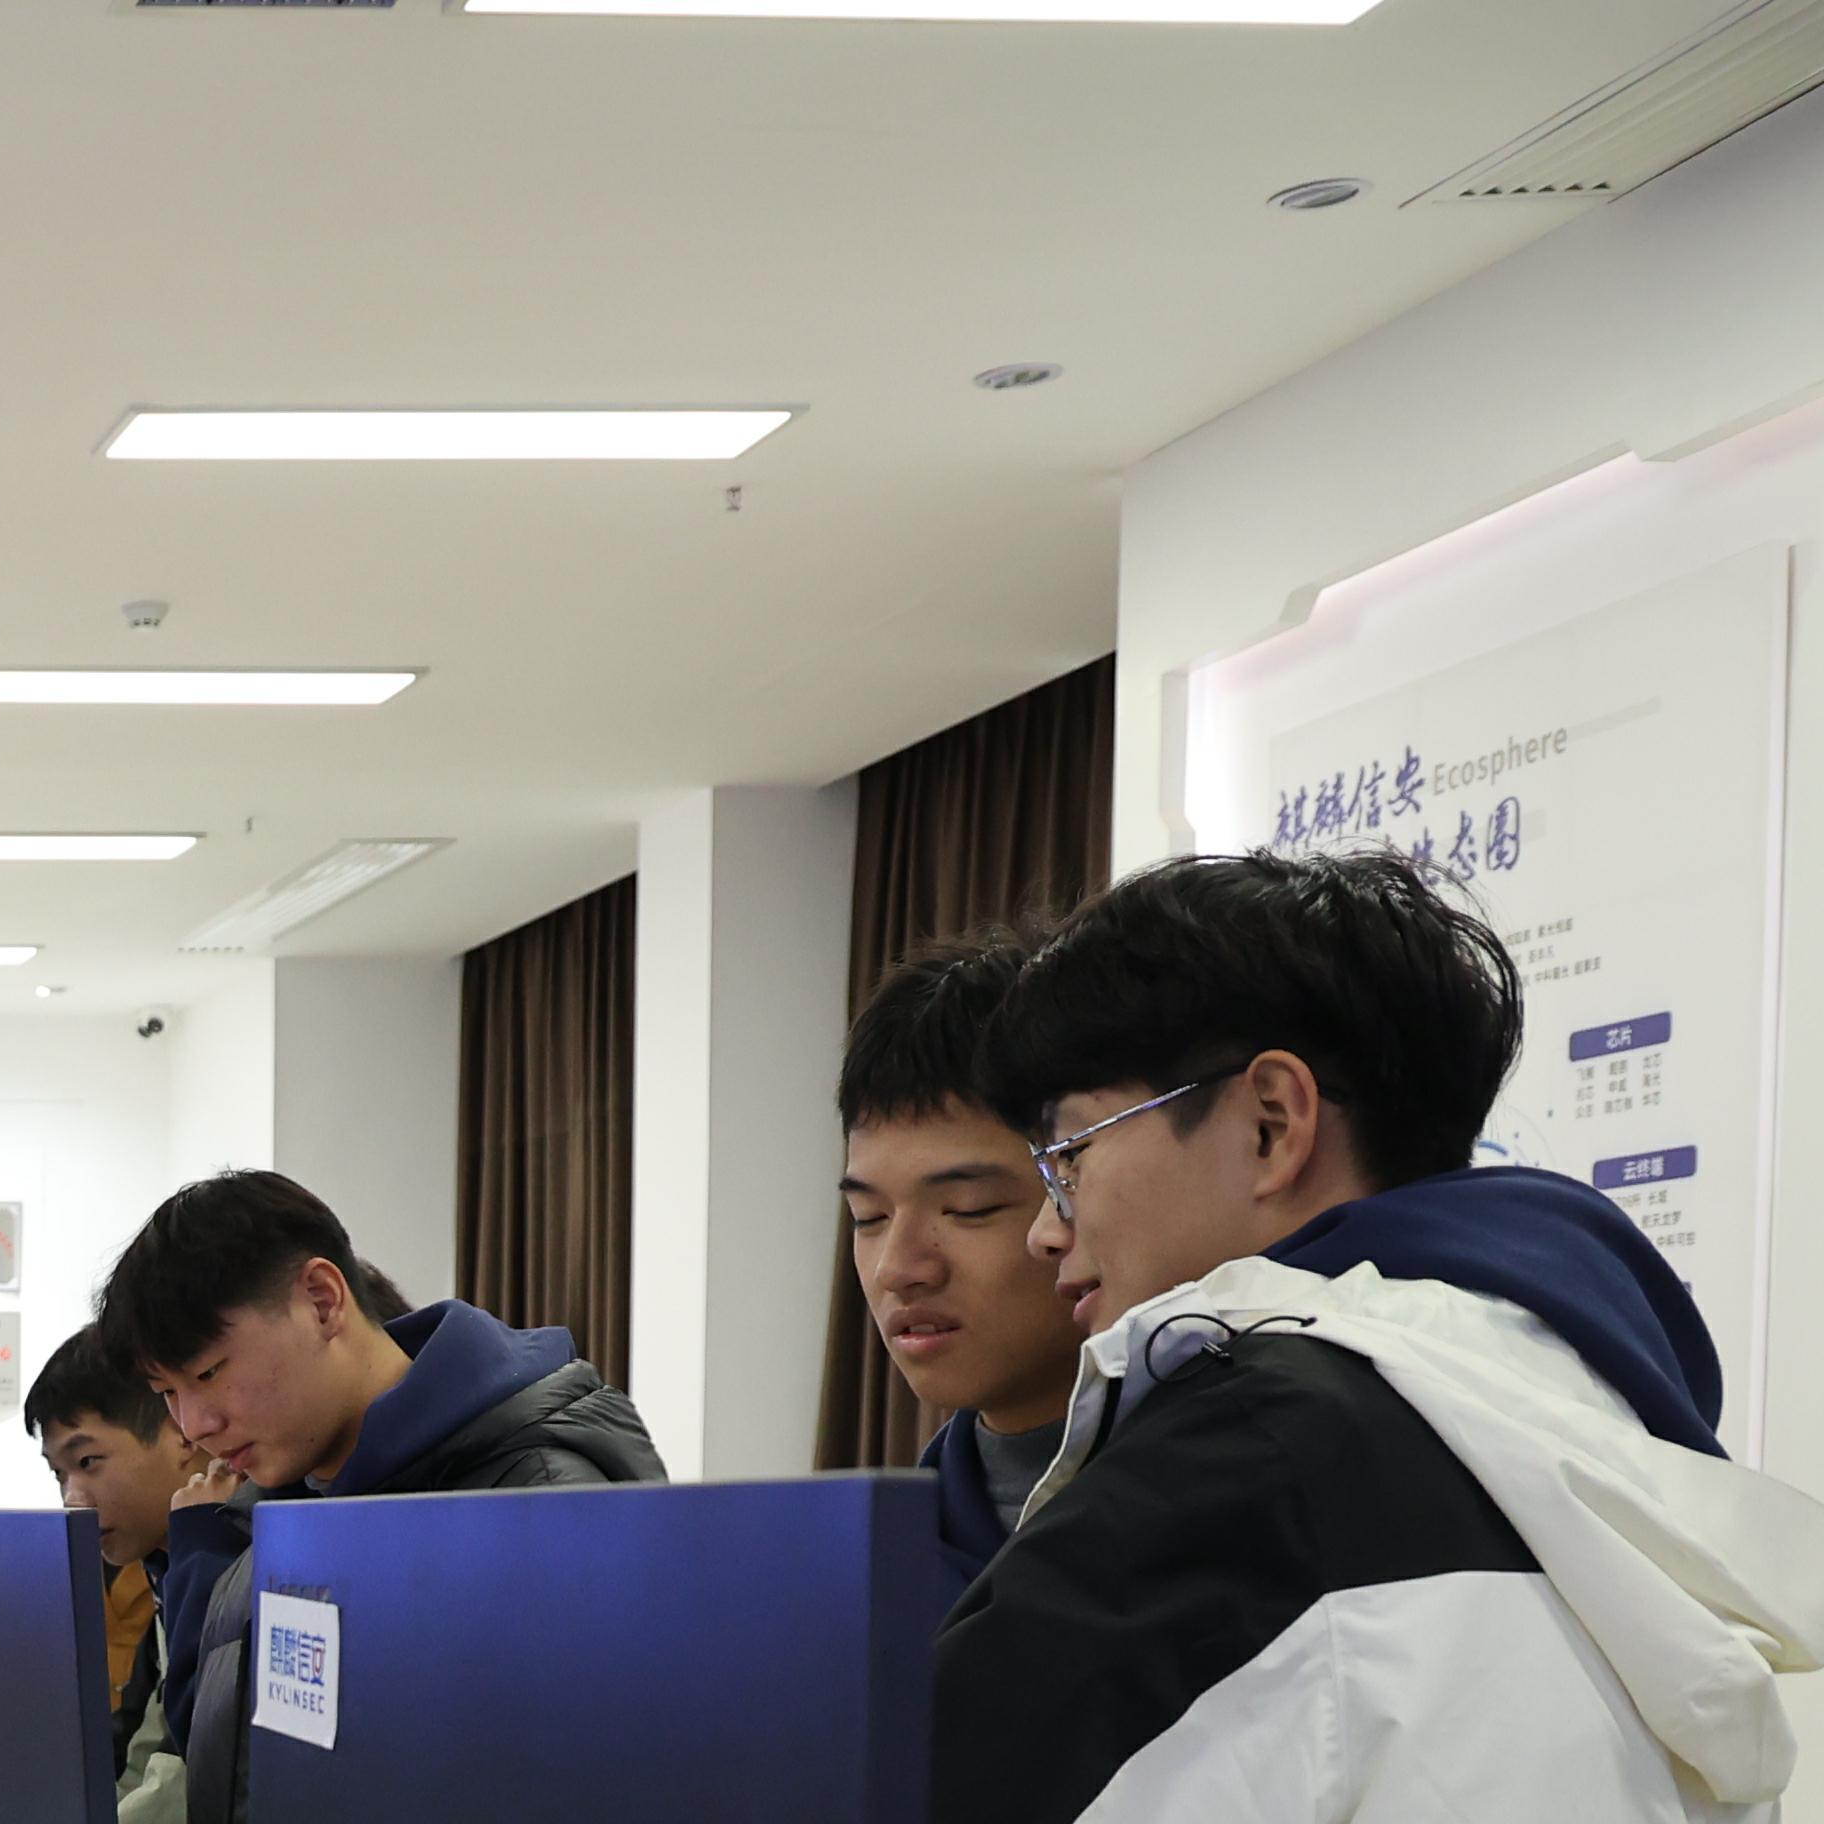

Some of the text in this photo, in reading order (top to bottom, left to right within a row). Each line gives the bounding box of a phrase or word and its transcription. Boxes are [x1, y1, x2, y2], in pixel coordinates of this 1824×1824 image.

[1433, 727, 1568, 796] Ecosphere
[1273, 746, 1425, 856] 麒麟信安
[1606, 1025, 1632, 1049] 芯片
[1623, 1156, 1664, 1181] 云终端
[269, 1681, 325, 1714] KYLINSEC
